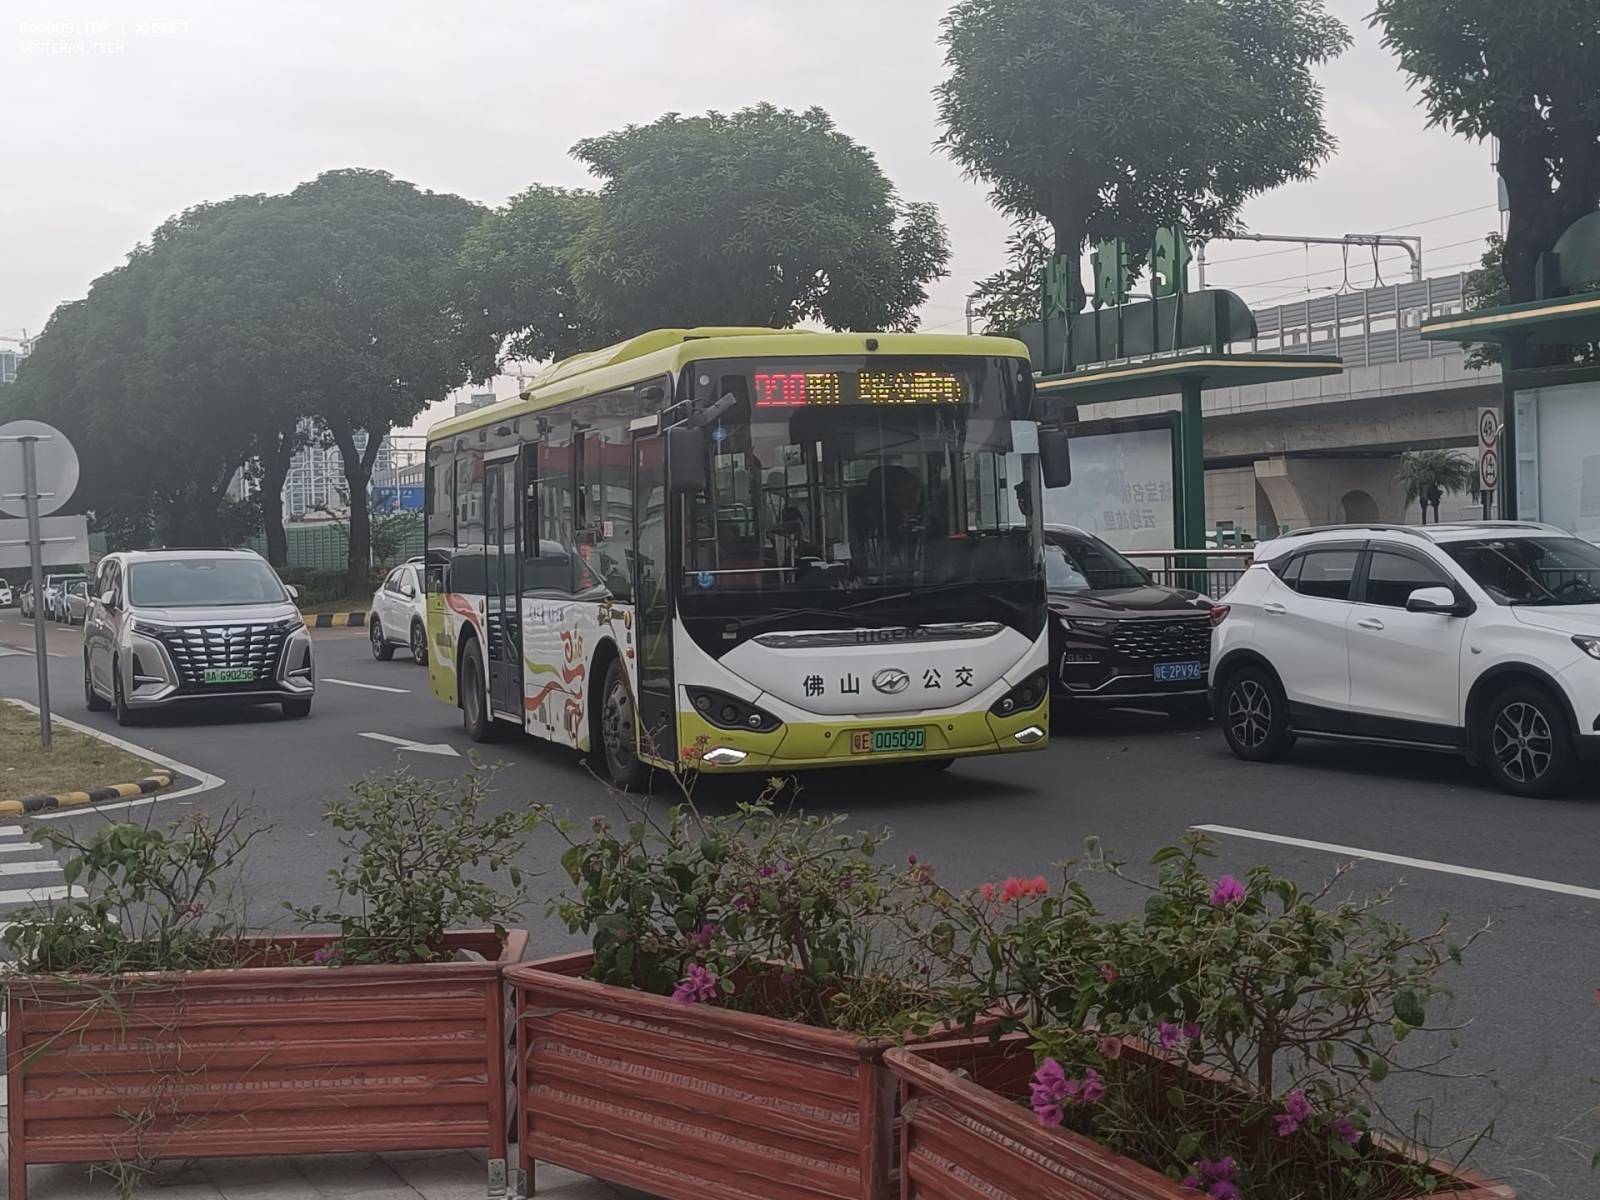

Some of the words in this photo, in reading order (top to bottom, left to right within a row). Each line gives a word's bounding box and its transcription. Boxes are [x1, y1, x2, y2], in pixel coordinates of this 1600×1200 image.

[802, 672, 861, 697] 佛山
[922, 665, 975, 690] 公交
[875, 730, 924, 750] 00509D
